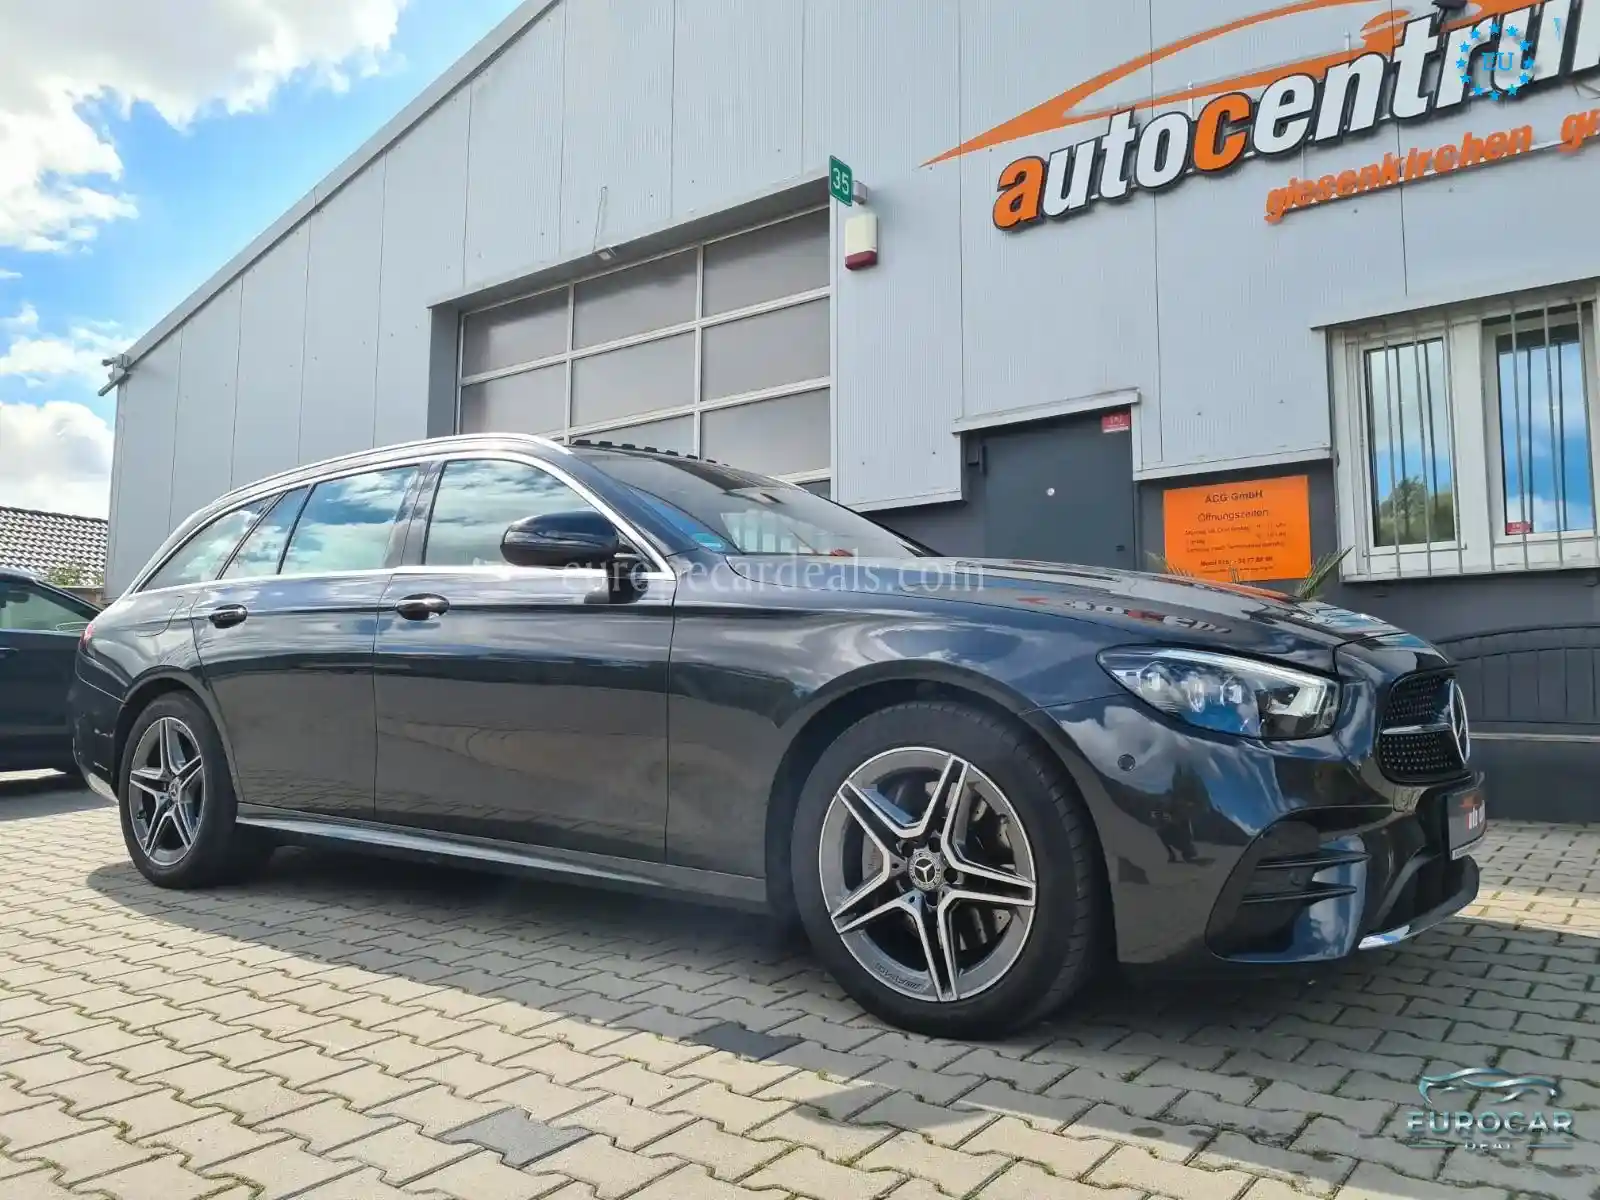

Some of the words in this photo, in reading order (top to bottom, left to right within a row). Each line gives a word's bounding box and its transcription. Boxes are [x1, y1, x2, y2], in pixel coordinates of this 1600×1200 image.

[832, 167, 849, 195] 35
[1263, 124, 1533, 225] giesenkirchen
[1204, 492, 1228, 504] ACG
[1231, 489, 1264, 501] GmbH
